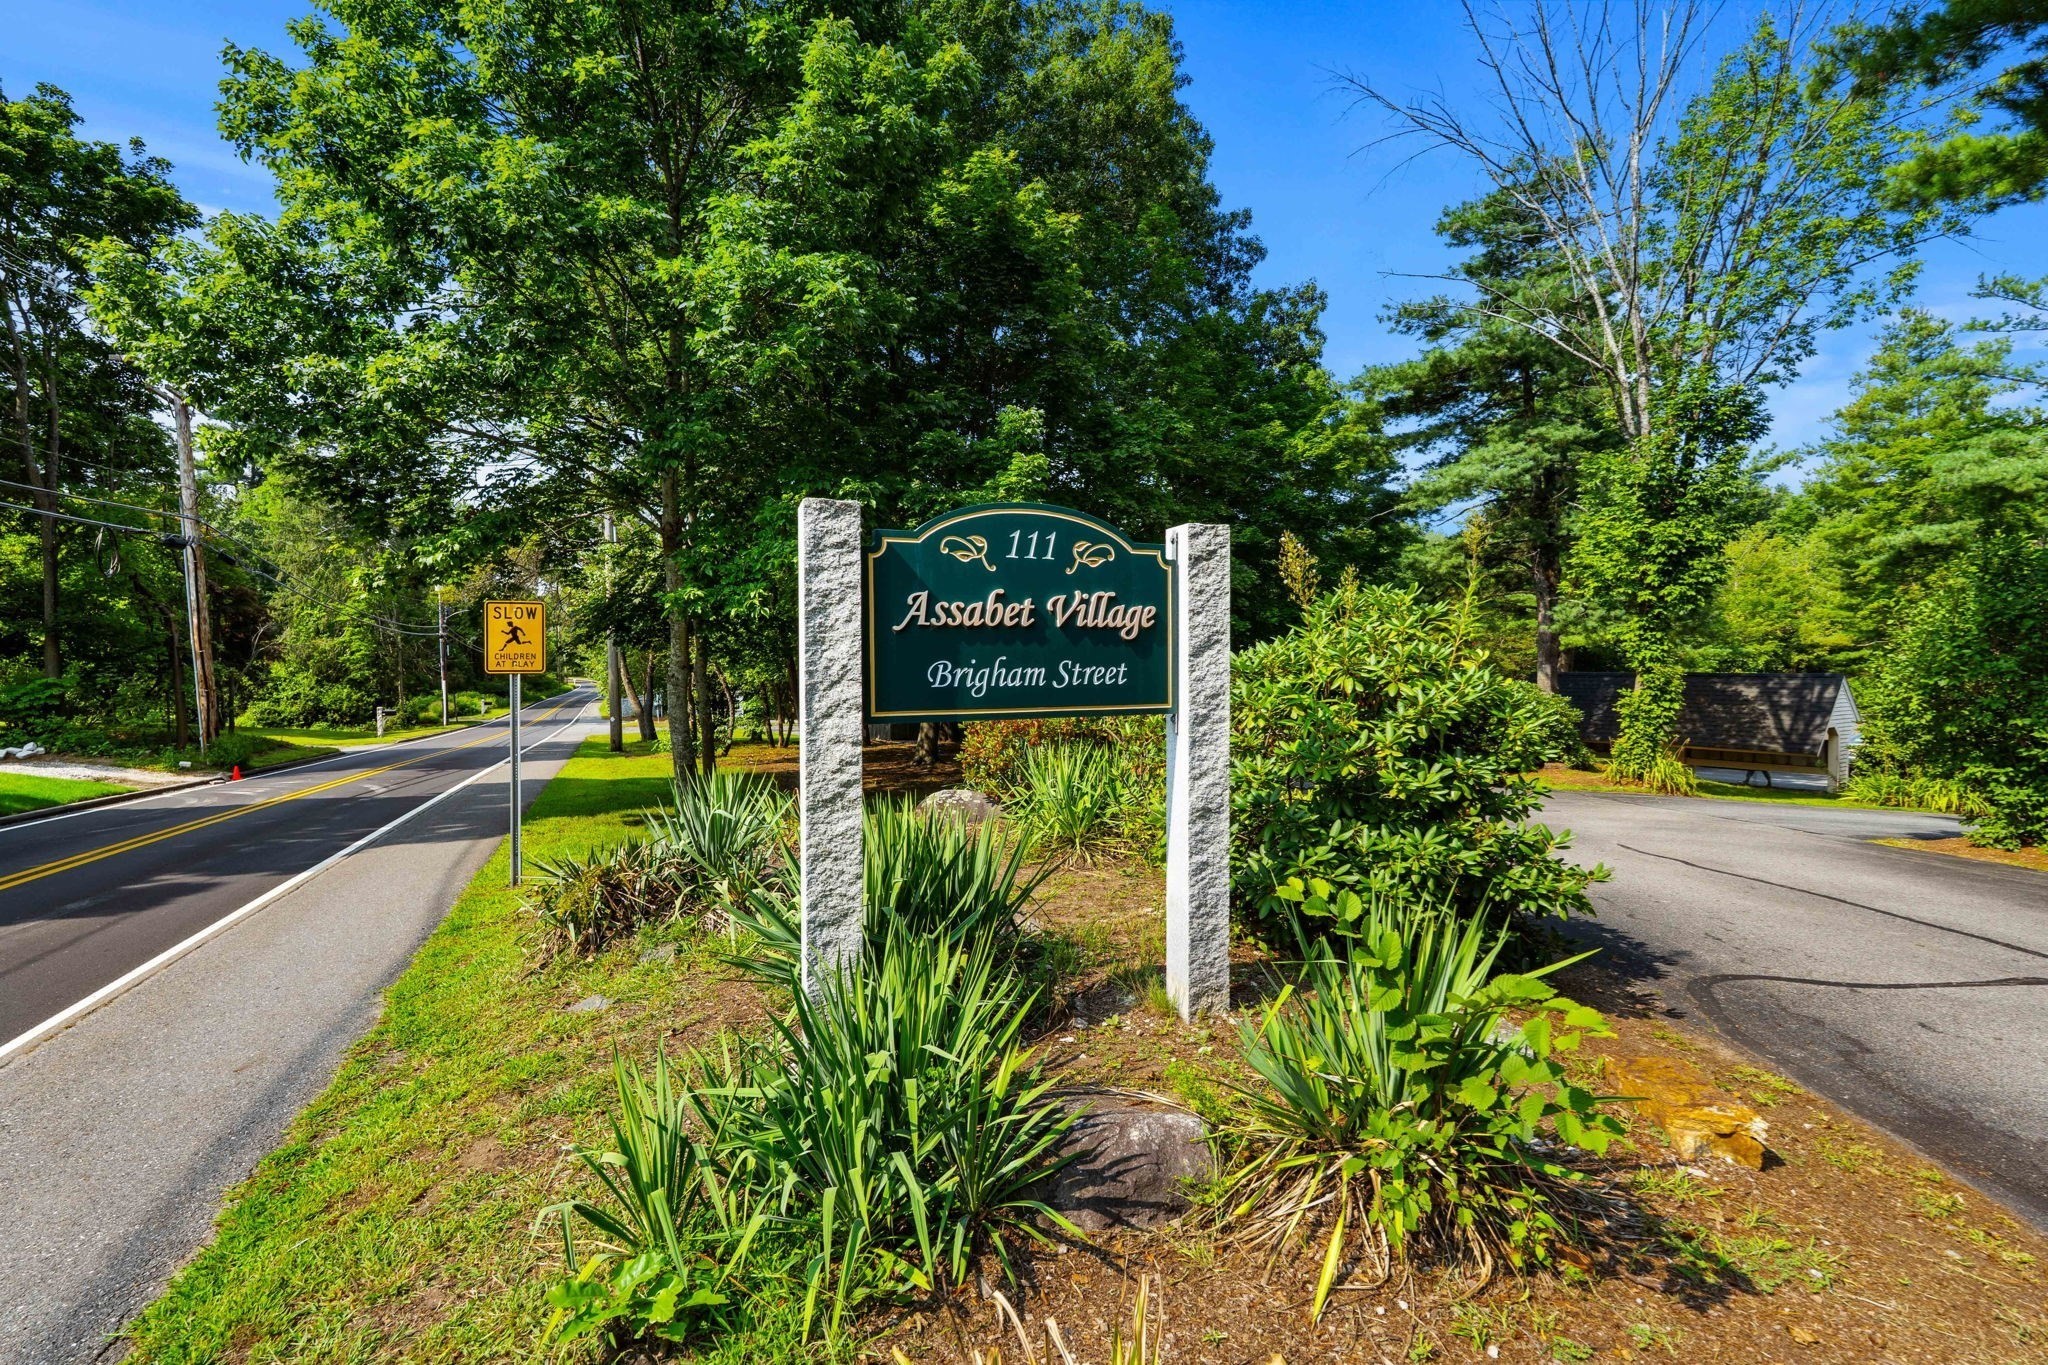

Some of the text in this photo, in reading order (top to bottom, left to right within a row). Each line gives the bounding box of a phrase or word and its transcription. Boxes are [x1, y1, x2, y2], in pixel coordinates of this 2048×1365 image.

[1005, 529, 1056, 560] 111
[493, 606, 537, 619] SLOW
[892, 588, 1157, 640] Assabet Village
[927, 656, 1127, 698] Brigham Street
